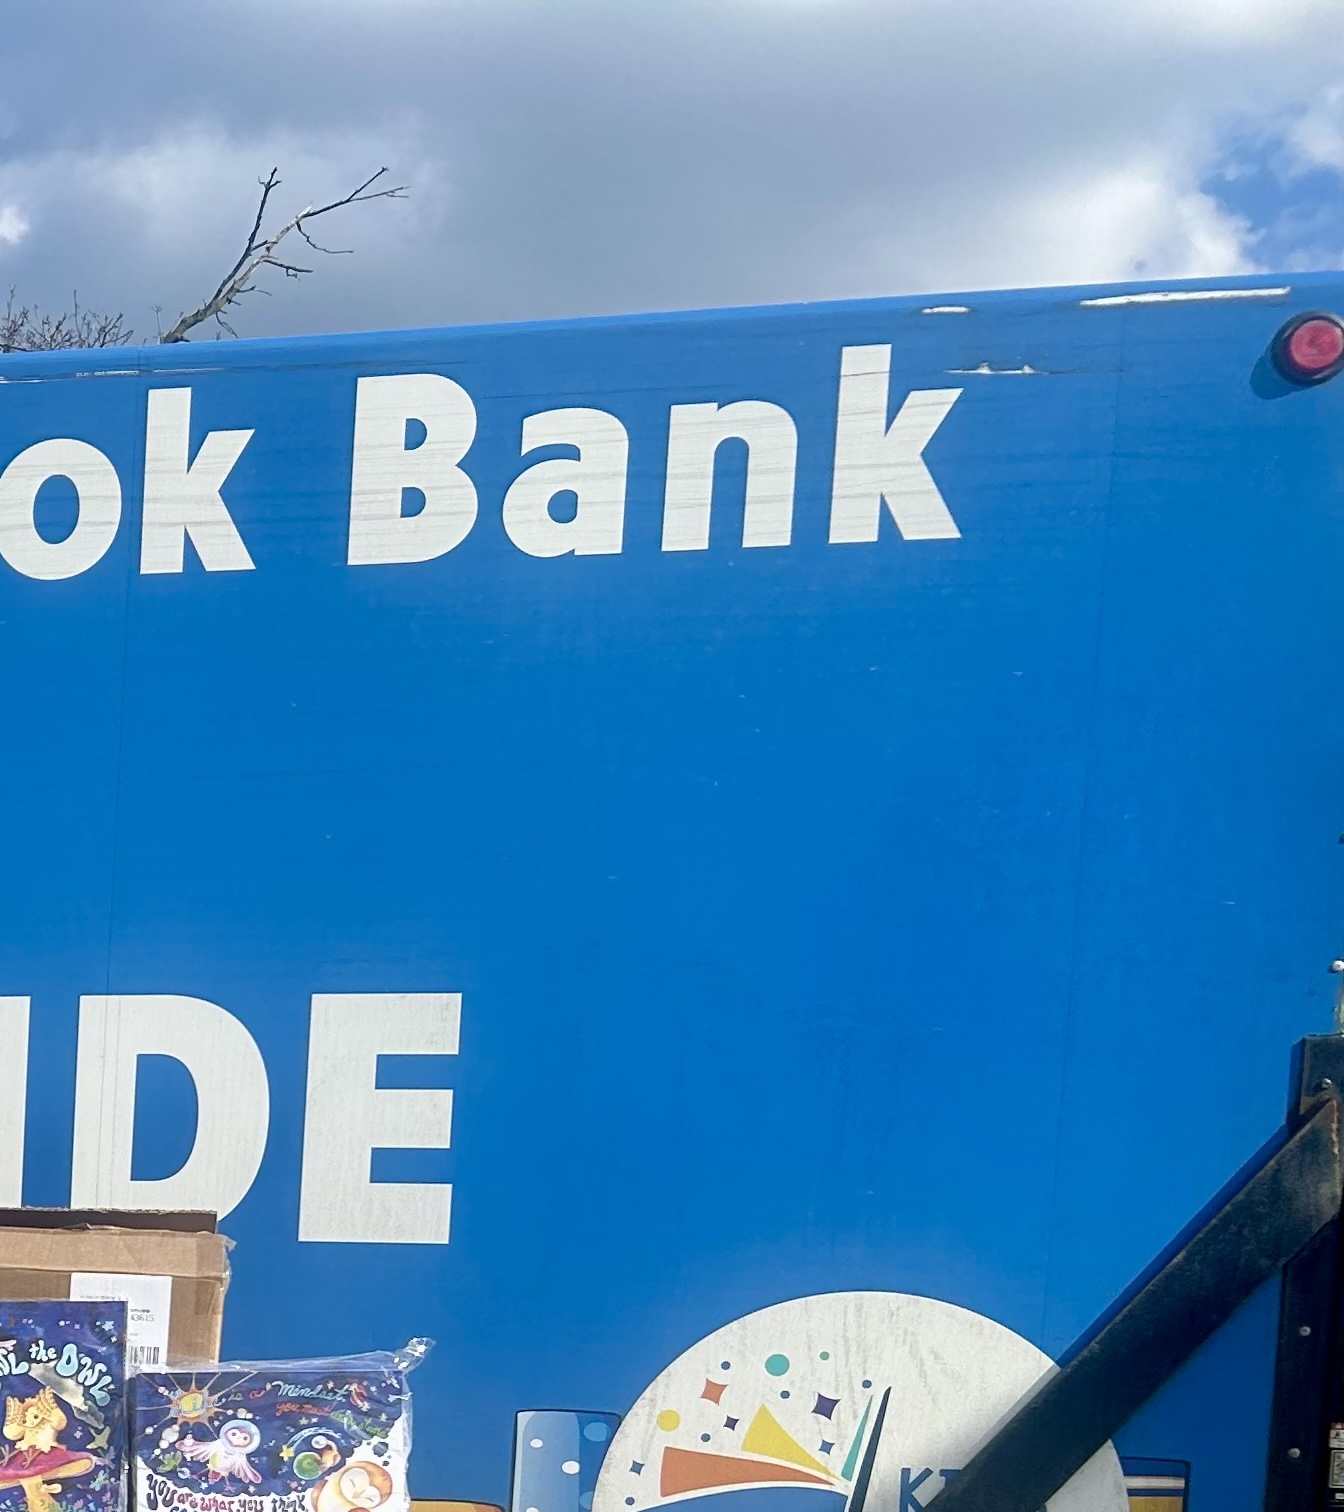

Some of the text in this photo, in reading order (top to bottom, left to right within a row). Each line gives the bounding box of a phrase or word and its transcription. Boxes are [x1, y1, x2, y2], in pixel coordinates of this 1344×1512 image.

[348, 344, 963, 565] Bank
[29, 1340, 56, 1361] the
[56, 1343, 112, 1406] OWL
[177, 1493, 198, 1508] are
[200, 1497, 234, 1512] what
